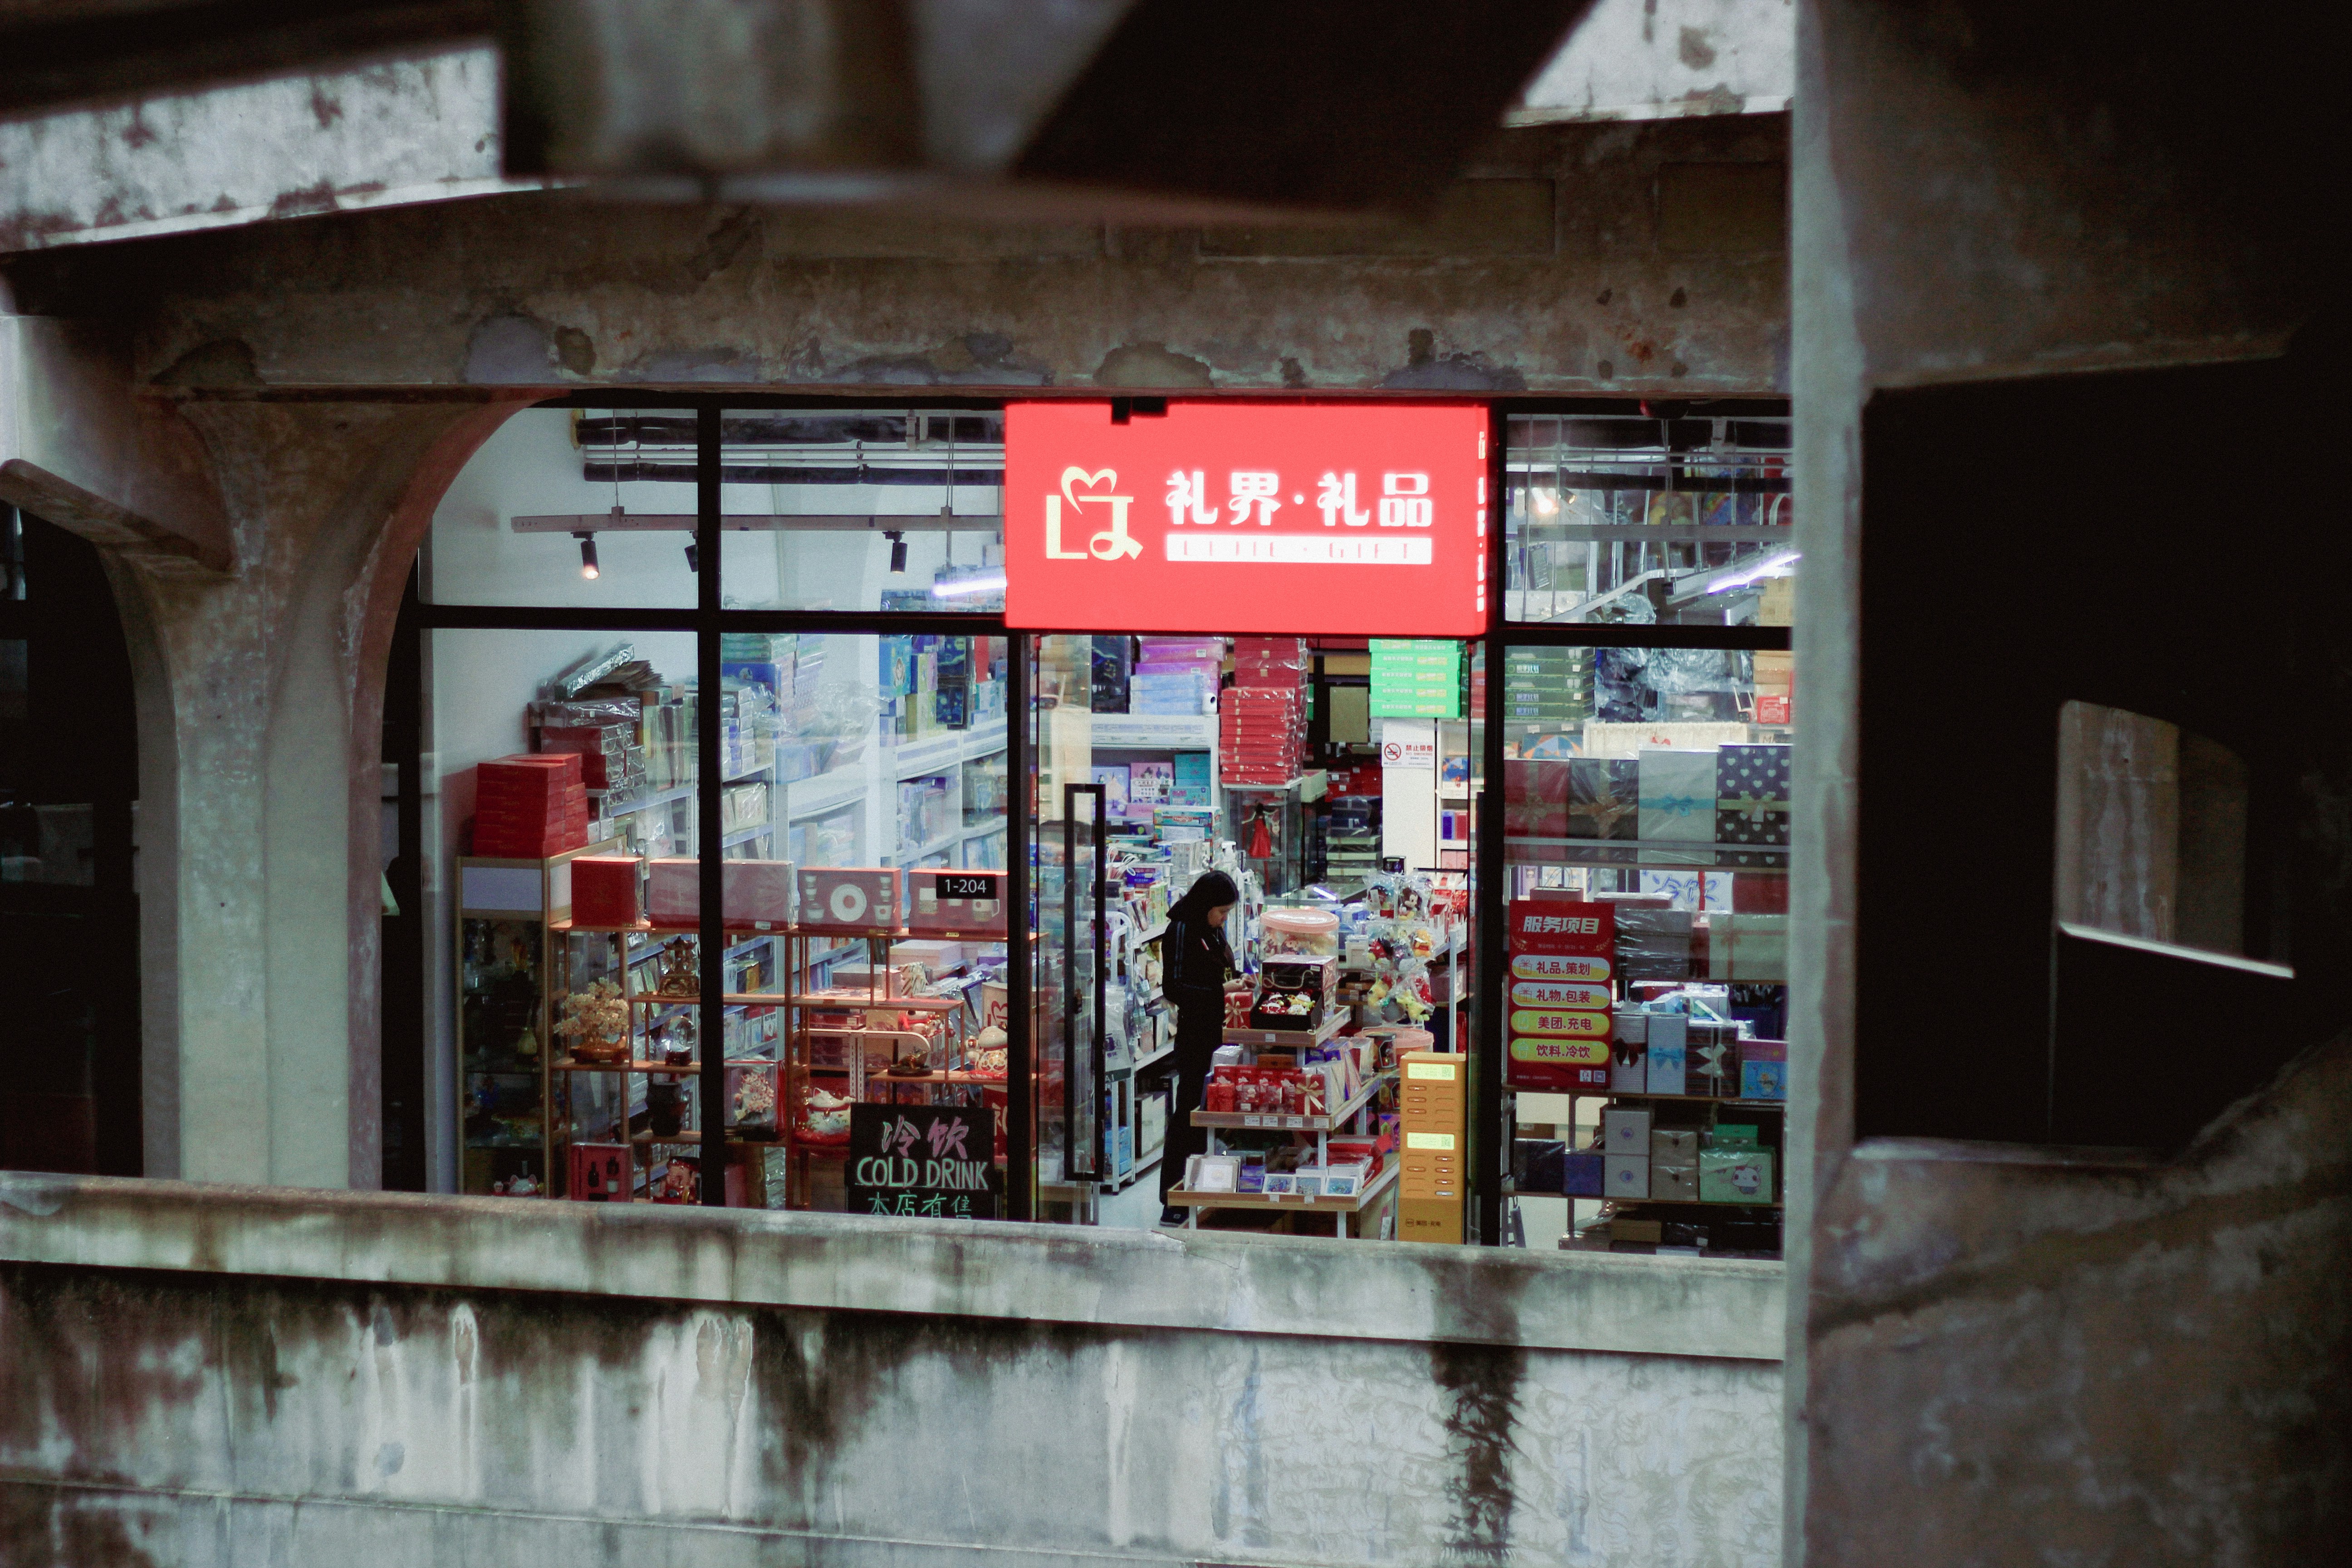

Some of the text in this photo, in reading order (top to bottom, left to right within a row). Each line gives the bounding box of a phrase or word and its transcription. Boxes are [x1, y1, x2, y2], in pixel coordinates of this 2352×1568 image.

[945, 879, 987, 893] 1-204
[1523, 916, 1600, 934] 服务项目
[882, 1114, 969, 1159] 冷饮
[857, 1156, 989, 1190] COLD DRINK
